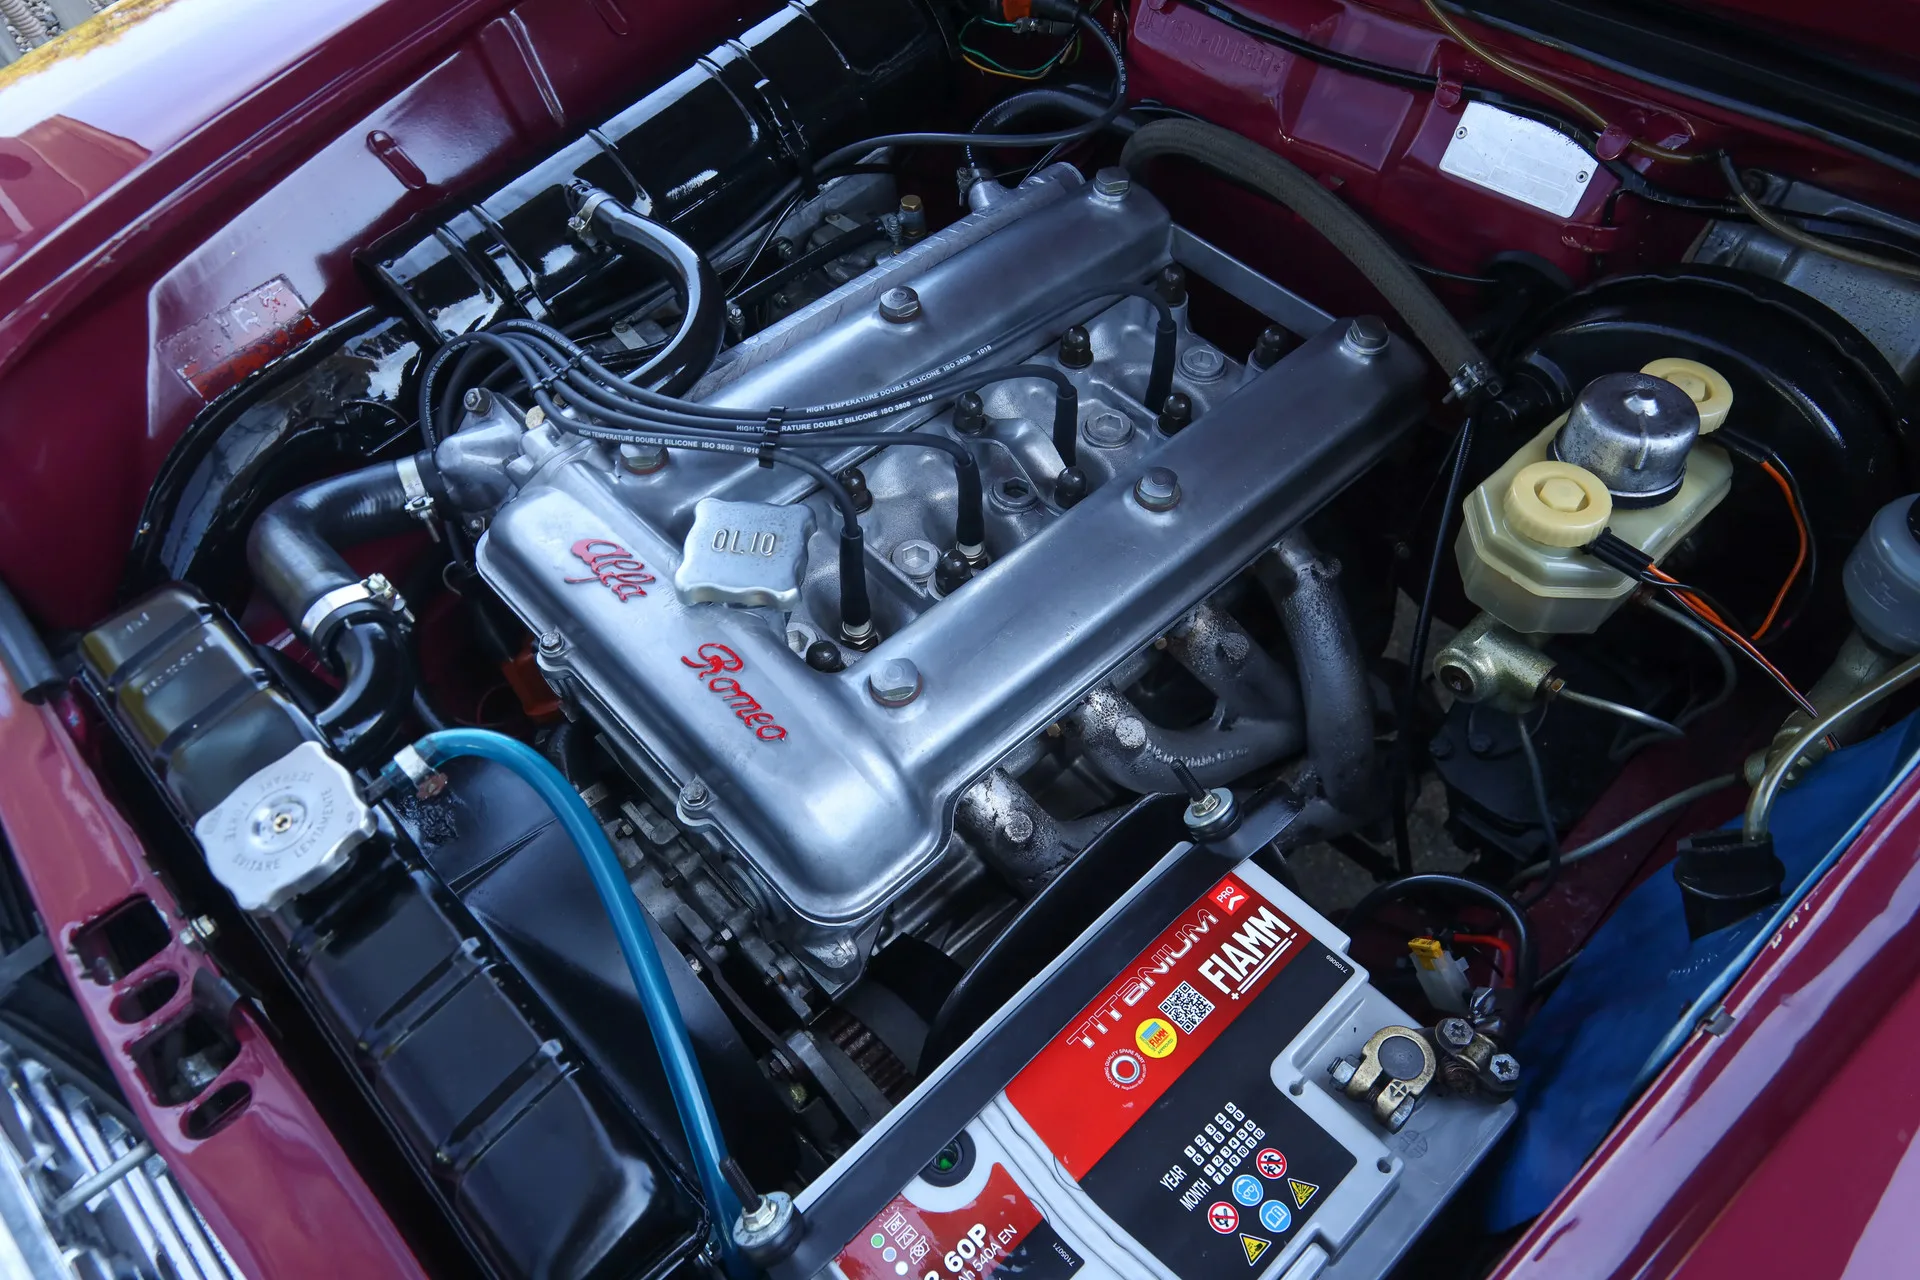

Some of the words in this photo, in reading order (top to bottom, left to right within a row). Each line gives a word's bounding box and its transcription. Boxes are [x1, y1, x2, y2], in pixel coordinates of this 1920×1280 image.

[427, 366, 438, 386] DOUBLE
[826, 392, 880, 410] TEMPERATURE
[880, 382, 909, 397] DOUBLE
[910, 369, 942, 386] SILICONE
[942, 362, 956, 372] ISO
[976, 344, 992, 356] 1018
[757, 424, 812, 432] TERATURE
[813, 418, 843, 429] DOUBLE
[844, 410, 878, 424] SILICONE
[880, 406, 894, 415] ISO
[894, 400, 912, 411] 3808
[917, 394, 934, 404] 1018
[592, 431, 634, 442] TEMPERATURE
[635, 436, 662, 445] DOUBLE
[664, 439, 698, 448] SILICONE
[711, 528, 778, 558] OLIO
[681, 643, 789, 741] Romeo
[294, 788, 334, 858] LENTAMENTE
[1216, 886, 1234, 903] PRO
[1198, 906, 1291, 995] FIAMM
[1326, 955, 1348, 974] 7105069
[1149, 1028, 1168, 1048] FIAMM
[1104, 1050, 1118, 1066] QUALITY
[1134, 1052, 1145, 1064] PART
[1185, 1147, 1195, 1156] 1
[1196, 1136, 1205, 1145] 2
[1206, 1125, 1215, 1134] 3
[1216, 1114, 1225, 1123] 4
[1226, 1103, 1235, 1112] 5
[1194, 1155, 1203, 1164] 6
[1204, 1144, 1213, 1153] 7
[1214, 1133, 1224, 1142] 8
[1224, 1122, 1234, 1131] 9
[1234, 1111, 1244, 1120] 0
[1205, 1166, 1214, 1175] 1
[1213, 1156, 1222, 1166] 2
[1221, 1147, 1231, 1157] 3
[1230, 1139, 1239, 1148] 4
[1238, 1130, 1247, 1139] 5
[1246, 1121, 1255, 1130] 6
[1214, 1174, 1223, 1183] 7
[1222, 1165, 1232, 1174] 8
[1230, 1156, 1240, 1165] 9
[1238, 1147, 1248, 1156] 10
[1246, 1138, 1256, 1148] 11
[1254, 1129, 1264, 1139] 12
[1160, 1165, 1187, 1191] YEAR
[1179, 1178, 1212, 1212] MONTH
[890, 1218, 901, 1231] OK
[944, 1224, 986, 1272] 60P
[972, 1242, 1002, 1272] 540A
[998, 1224, 1018, 1244] EN
[1052, 1242, 1075, 1267] 7105071
